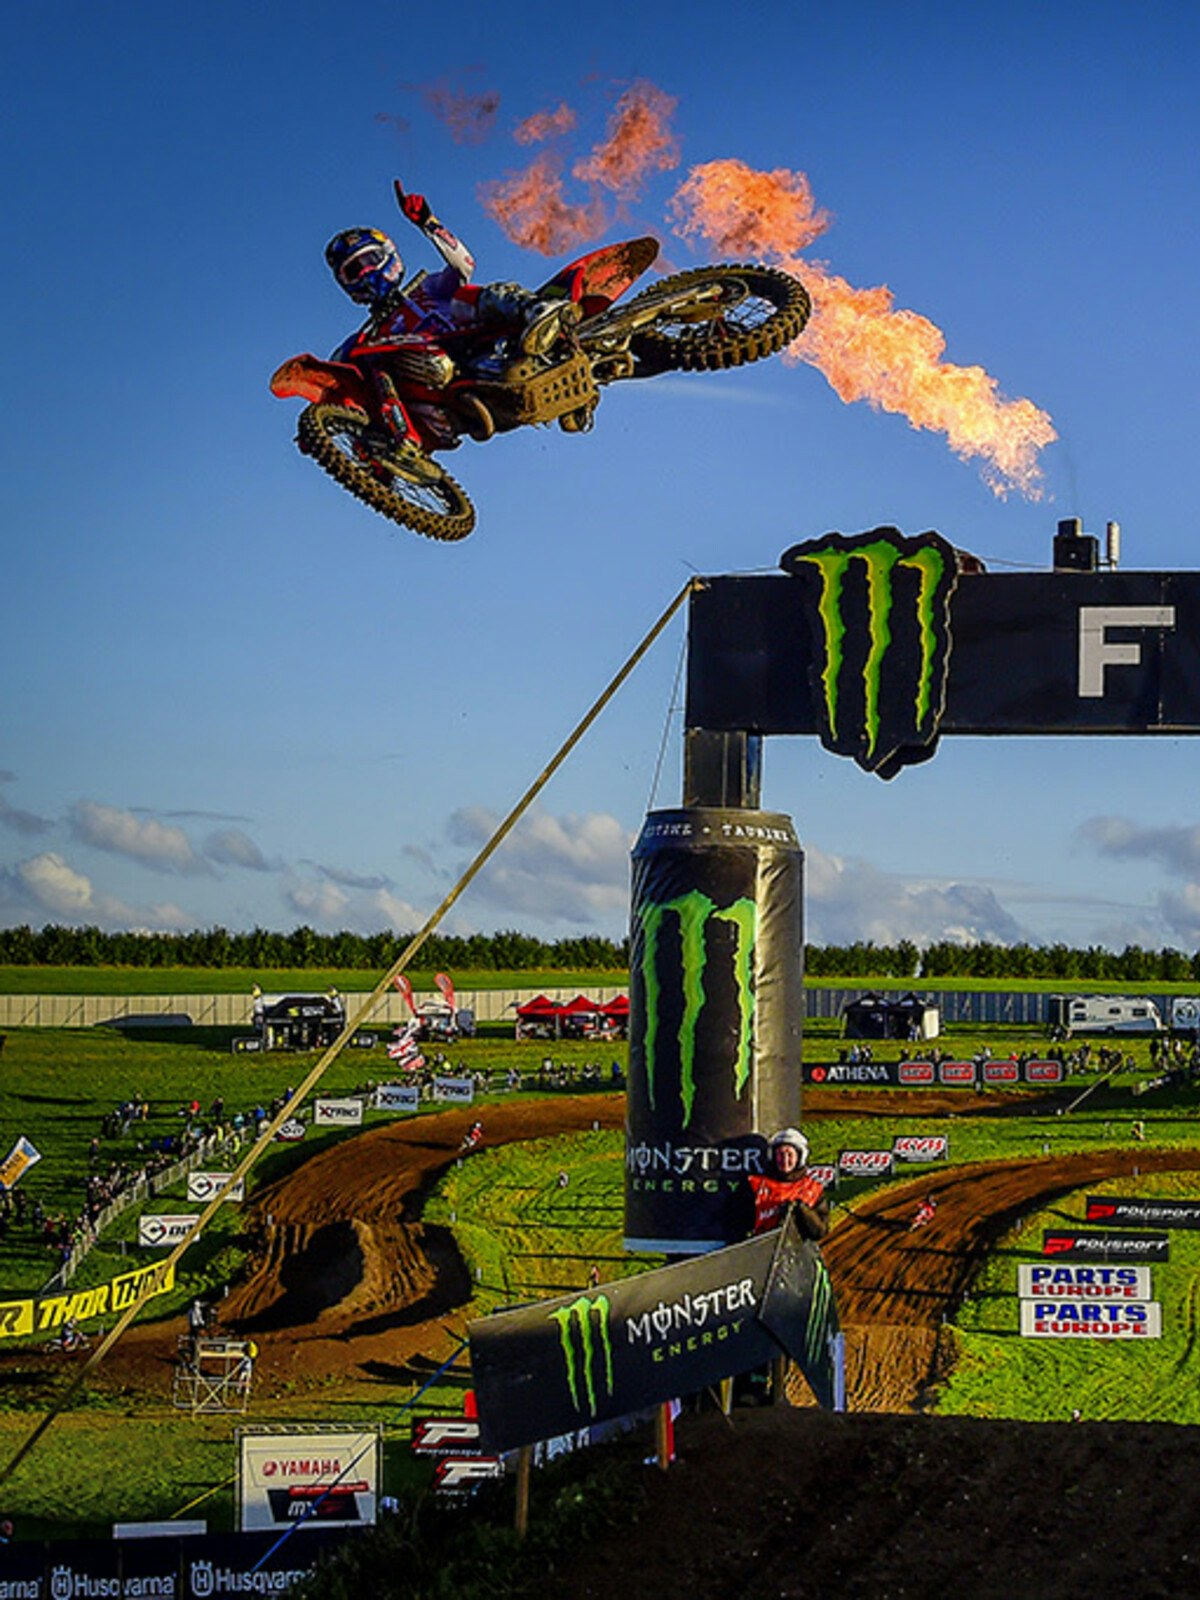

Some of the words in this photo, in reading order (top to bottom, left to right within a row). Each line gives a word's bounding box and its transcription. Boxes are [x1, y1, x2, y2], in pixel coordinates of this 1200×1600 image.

[826, 1066, 890, 1082] ATHENA
[318, 1105, 359, 1119] XTRIG
[1031, 1267, 1138, 1285] PARTS
[1031, 1284, 1139, 1297] EUROPE
[38, 1285, 109, 1330] THOR
[626, 1278, 757, 1345] MONSTER
[1034, 1303, 1147, 1322] PARTS
[1034, 1320, 1148, 1335] EUROPE
[652, 1318, 744, 1362] ENERGY
[280, 1459, 341, 1476] YAMAHA
